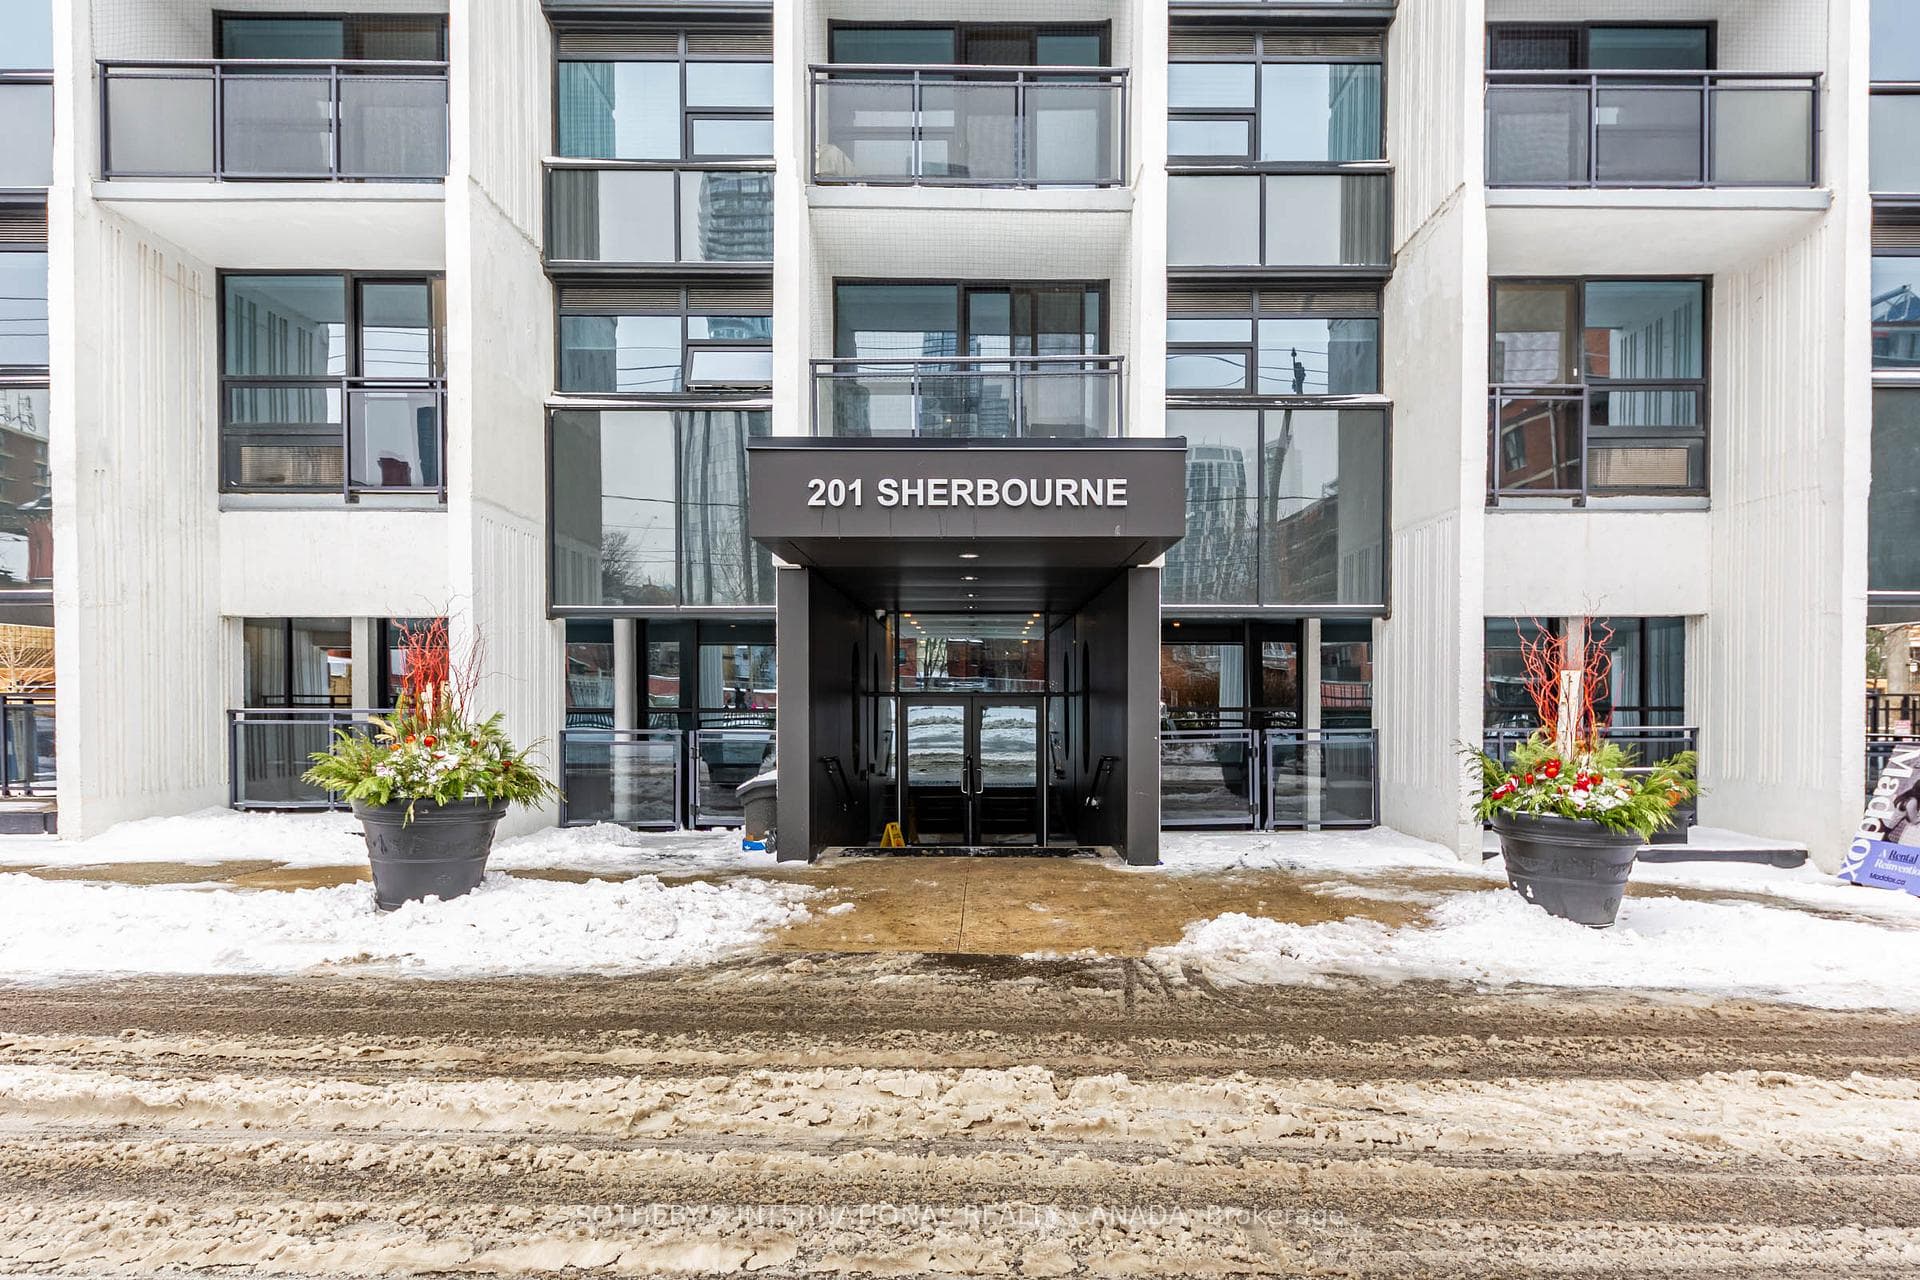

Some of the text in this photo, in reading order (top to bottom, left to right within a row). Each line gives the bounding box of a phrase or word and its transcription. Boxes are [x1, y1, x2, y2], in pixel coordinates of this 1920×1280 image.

[807, 478, 1128, 507] 201 SHERBOURNE
[1837, 748, 1920, 881] Maddox
[1888, 849, 1919, 865] Rental
[1869, 872, 1906, 886] Maddox.ca
